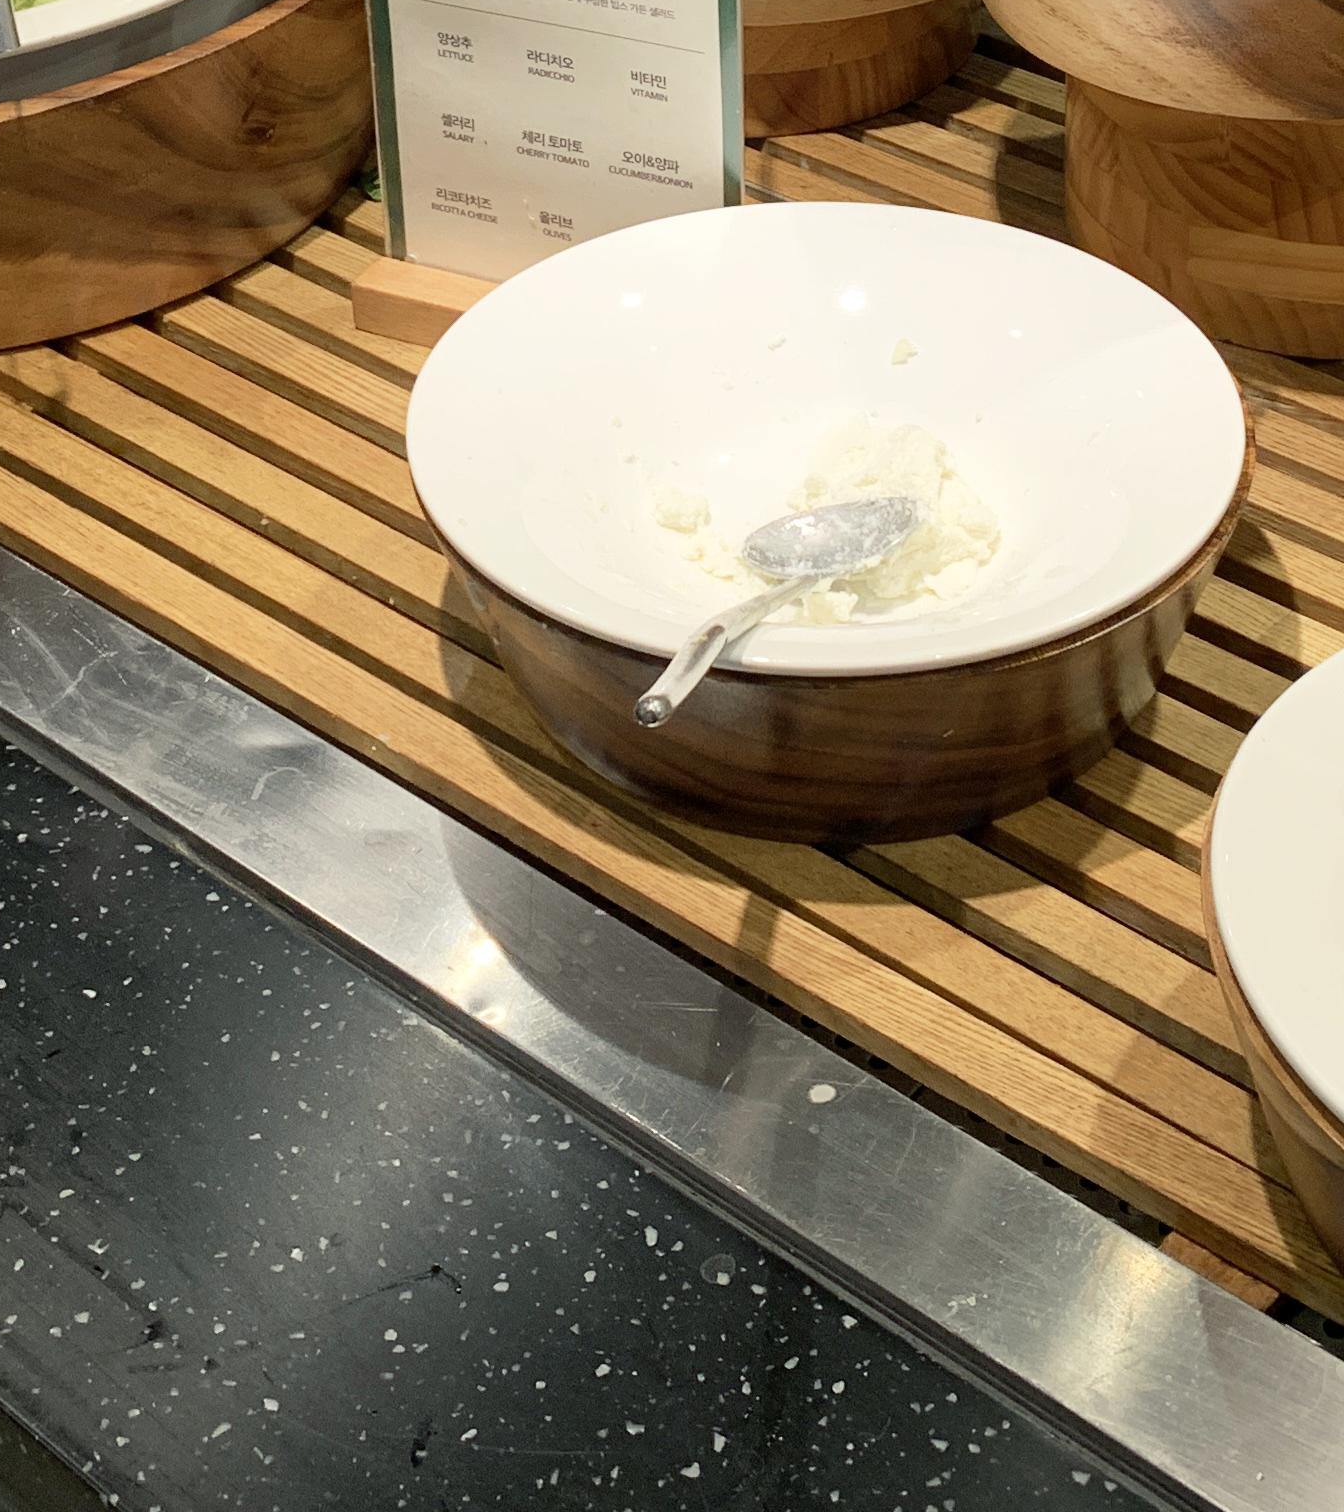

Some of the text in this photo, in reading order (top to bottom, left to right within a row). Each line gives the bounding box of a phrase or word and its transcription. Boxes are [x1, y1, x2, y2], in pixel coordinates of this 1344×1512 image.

[630, 3, 647, 15] 가든
[437, 31, 473, 49] 양상추
[437, 49, 474, 63] LETTUCE
[526, 49, 574, 70] 라디치오
[527, 67, 575, 83] RADICCHIO
[630, 70, 667, 90] 비타민
[630, 88, 668, 102] VITAMIN
[441, 113, 475, 132] 셀러리
[442, 130, 474, 144] SALARY
[522, 129, 584, 154] 체리 토마토
[516, 145, 590, 169] CHERRY TOMATO
[621, 151, 680, 174] 오이&양파
[608, 165, 693, 190] CUCUMBER&ONION
[436, 187, 493, 210] 리코타치즈
[431, 202, 498, 224] RICOTTA CHEESE
[539, 211, 574, 230] 올리브
[542, 228, 572, 242] OLIVES
